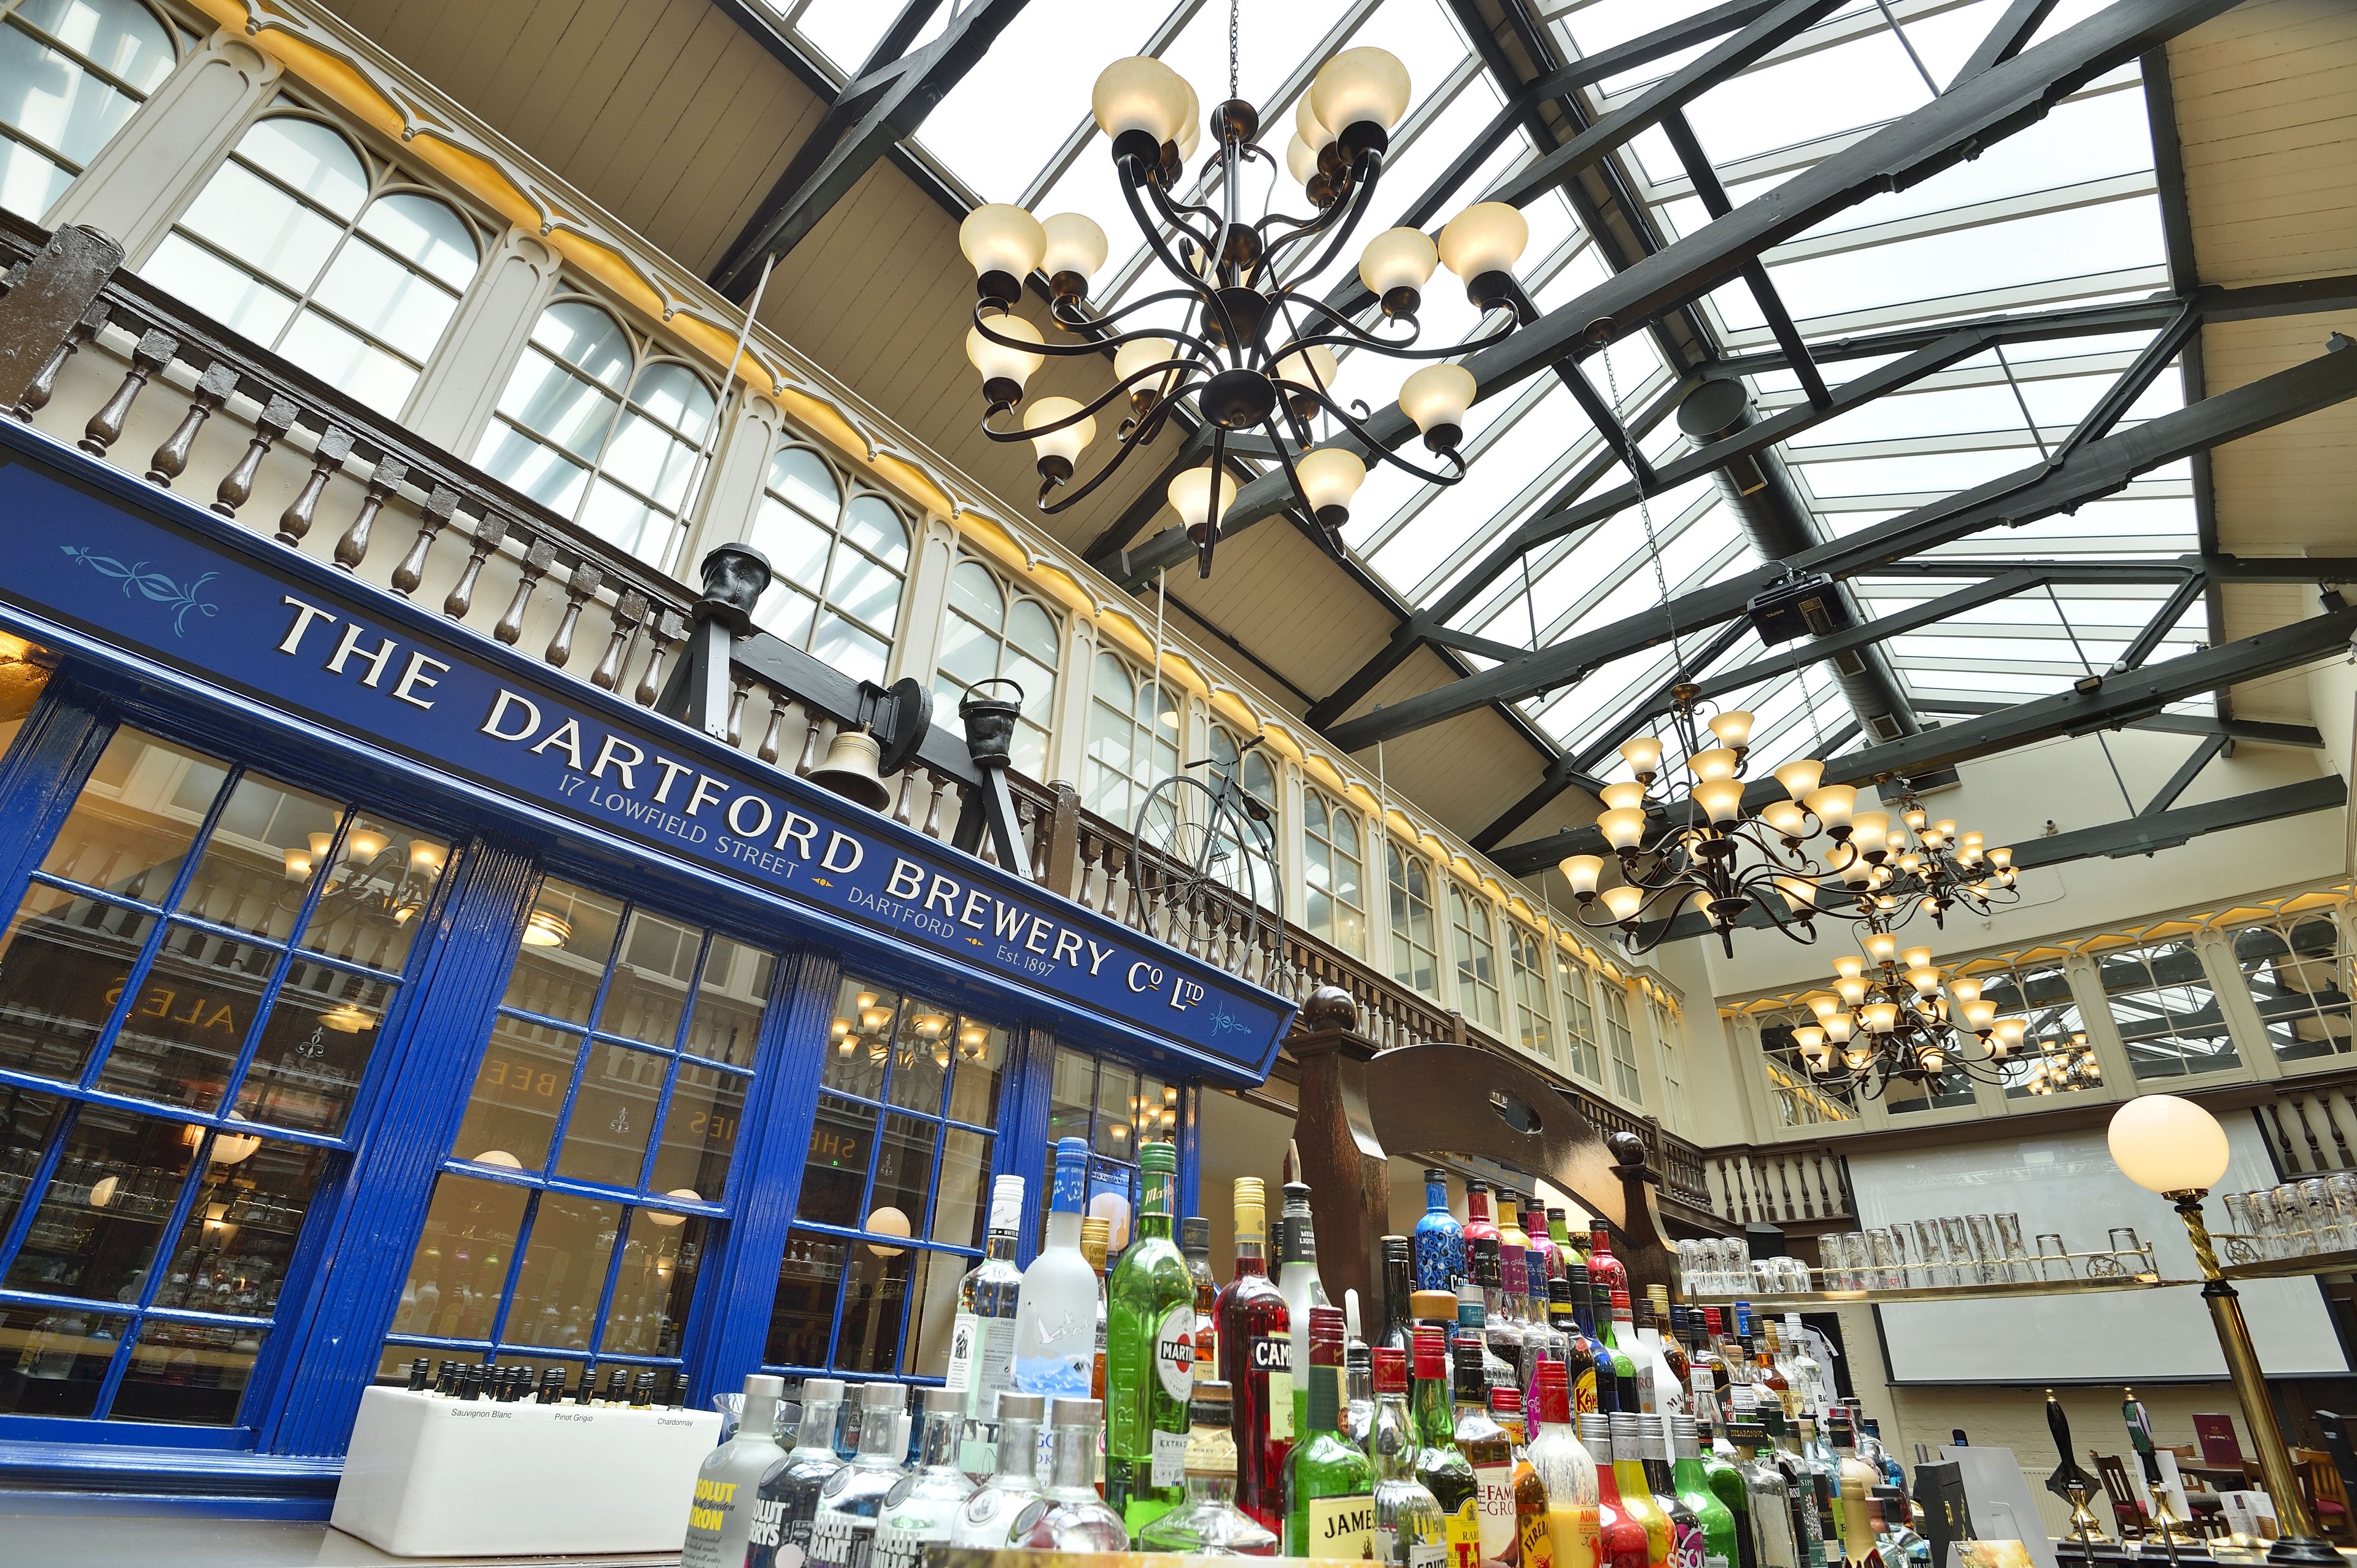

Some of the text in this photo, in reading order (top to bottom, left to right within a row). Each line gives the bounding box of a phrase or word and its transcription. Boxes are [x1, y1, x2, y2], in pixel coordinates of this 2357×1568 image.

[279, 595, 451, 709] THE
[481, 688, 864, 874] DARTFORD
[885, 857, 1115, 976] BREWERY
[559, 774, 1055, 978] 17 LOWFIELD STREET DARTFORD Est. 1897
[451, 1408, 512, 1419] Sauvignon Blanc
[554, 1413, 593, 1423] Pinot Grigio
[657, 1418, 694, 1427] Chardonnay
[695, 1478, 737, 1503] SOLUT
[1487, 1500, 1514, 1516] GRO
[813, 1512, 857, 1540] SOLUT
[1523, 1520, 1551, 1553] FIREBA
[808, 1535, 852, 1563] RANT
